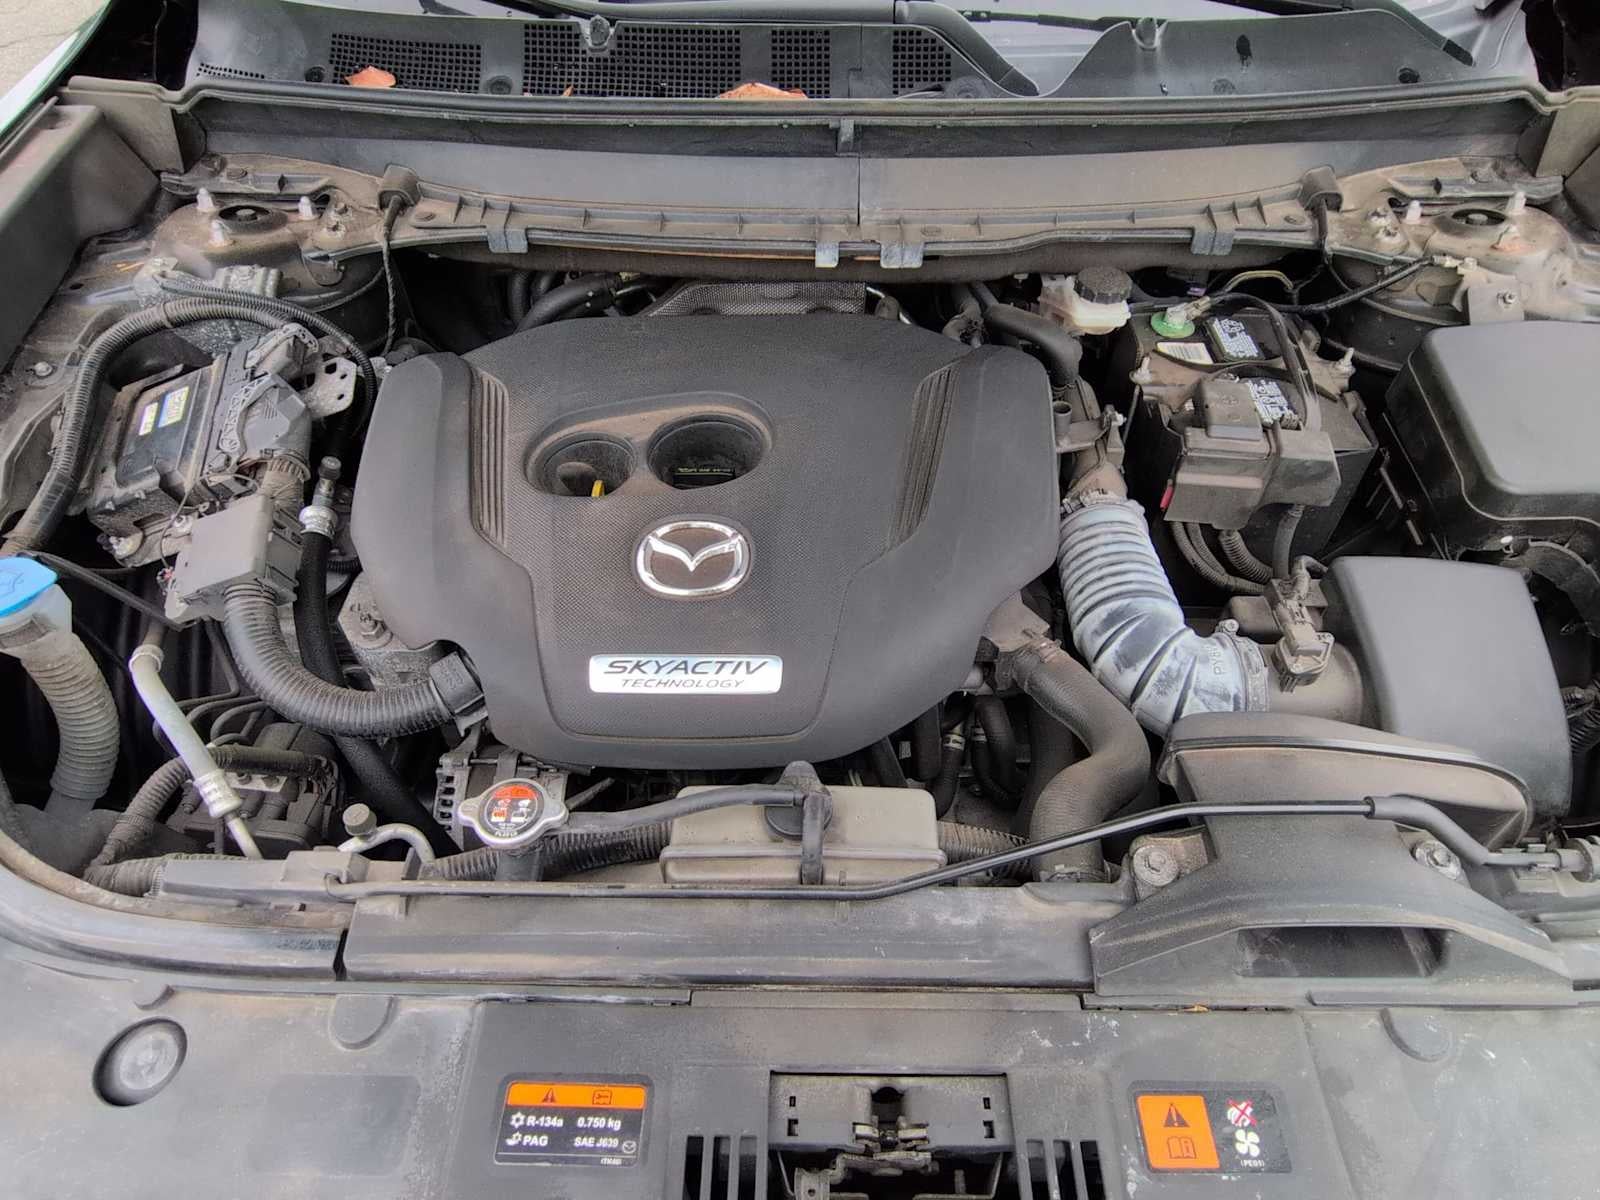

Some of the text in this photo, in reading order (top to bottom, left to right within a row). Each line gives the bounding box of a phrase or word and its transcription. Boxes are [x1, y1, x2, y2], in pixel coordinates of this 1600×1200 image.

[603, 660, 768, 675] SKYACTIV
[621, 678, 745, 689] TECHNOLOGY
[526, 1115, 621, 1131] R-134a 0.750 kg
[522, 1135, 549, 1146] PAG
[574, 1137, 595, 1148] SAE
